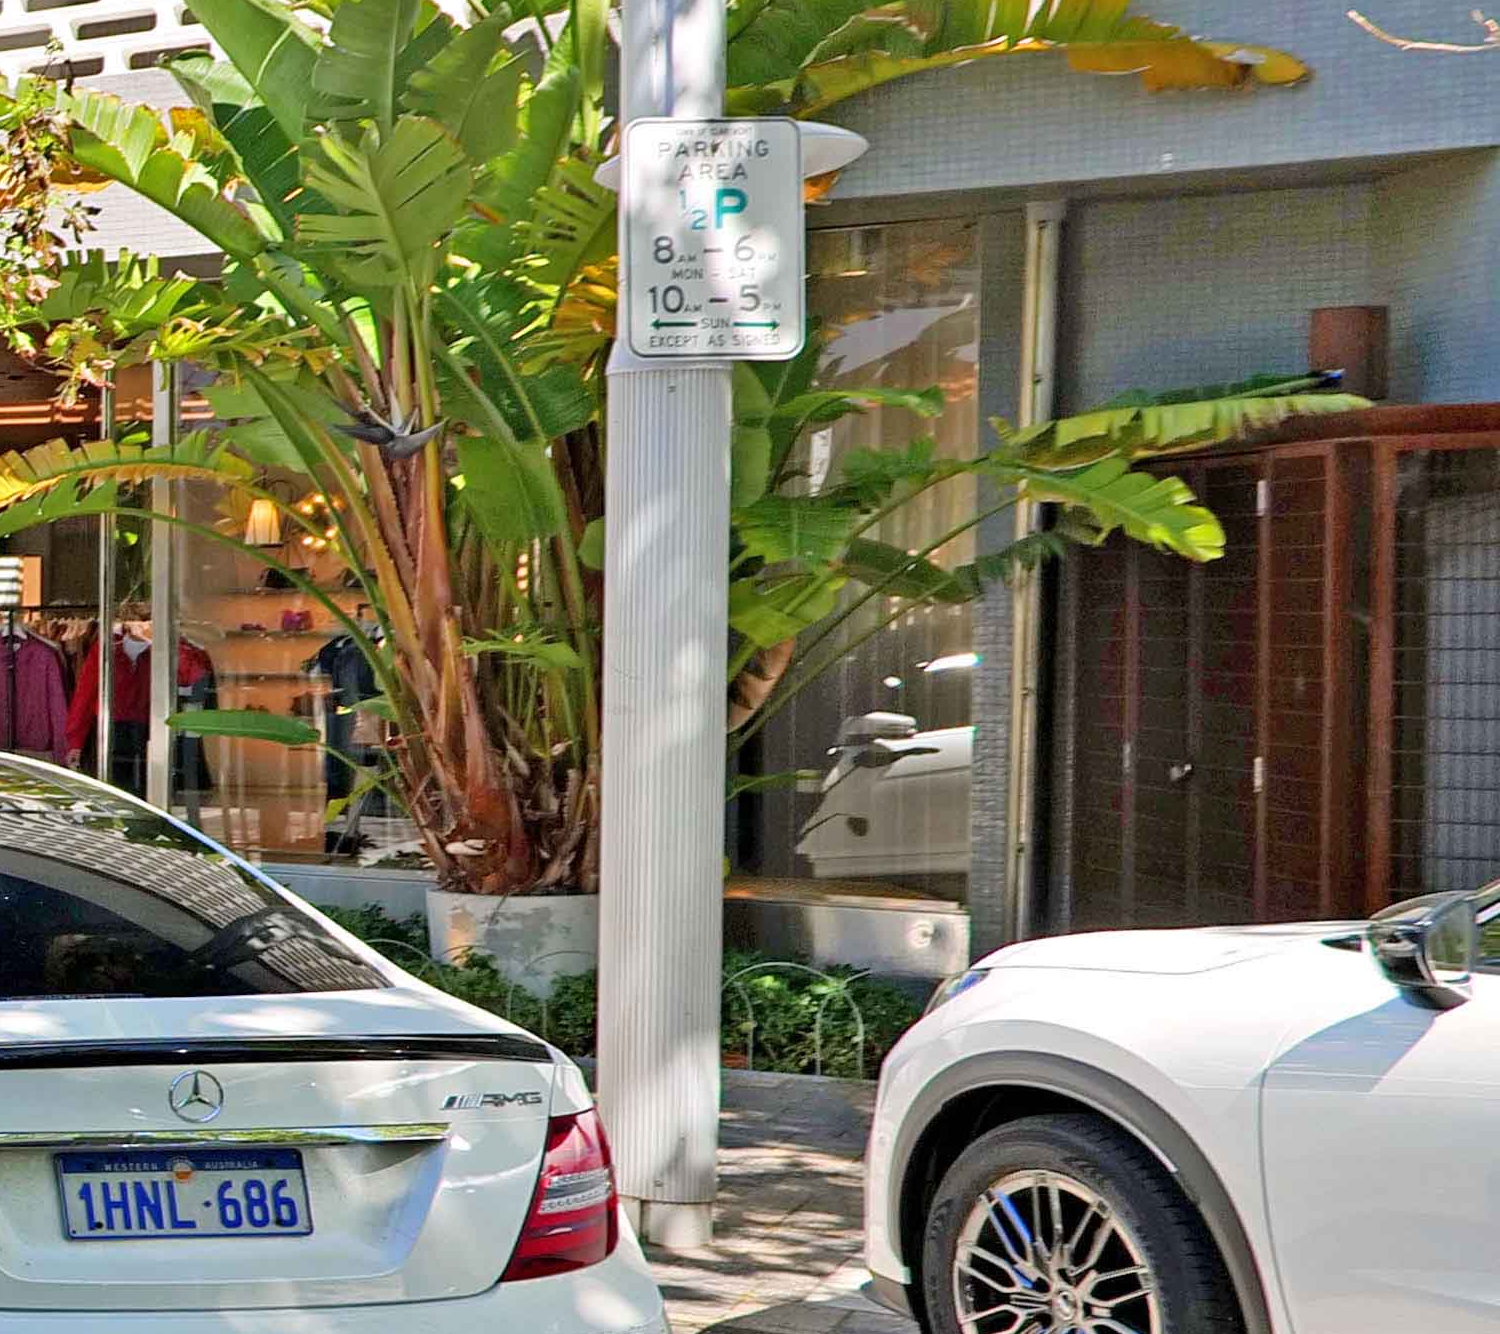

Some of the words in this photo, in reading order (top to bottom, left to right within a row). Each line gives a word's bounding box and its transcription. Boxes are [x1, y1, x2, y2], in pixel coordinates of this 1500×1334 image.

[658, 139, 770, 158] PARKING
[678, 162, 749, 182] AREA
[700, 316, 731, 329] SUN
[649, 335, 701, 349] EXCEPT
[707, 334, 726, 347] AS
[104, 1162, 159, 1172] WESTERN
[204, 1160, 260, 1170] AUSTRALIA
